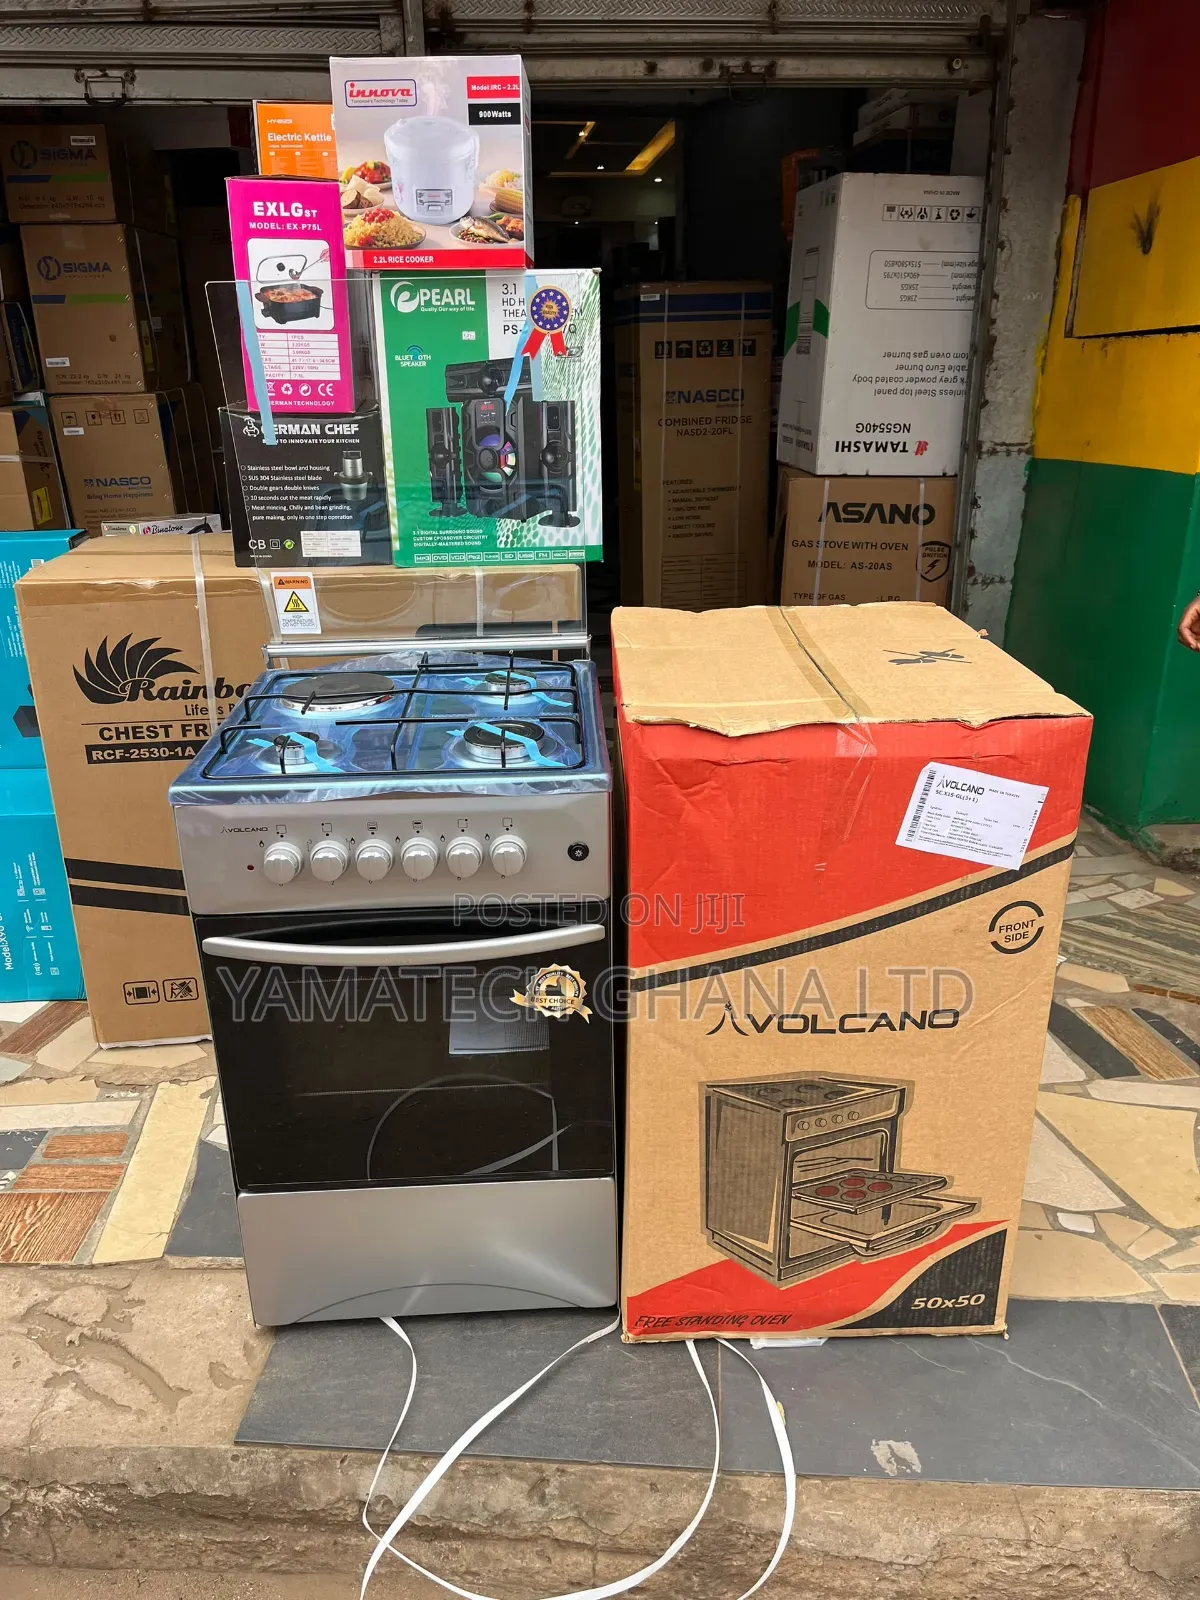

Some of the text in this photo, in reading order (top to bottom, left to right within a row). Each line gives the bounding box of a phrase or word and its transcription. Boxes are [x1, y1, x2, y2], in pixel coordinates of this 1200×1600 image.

[349, 83, 413, 98] innova
[268, 132, 332, 142] Electric Kettle
[40, 148, 97, 161] SIGMA
[249, 222, 322, 231] MODEL: EX-P75L
[373, 256, 388, 264] 2.2L
[388, 256, 404, 264] RICE
[63, 262, 112, 273] SIGMA
[502, 284, 516, 294] 3.1
[952, 283, 972, 291] weight
[420, 288, 476, 306] PEARL
[502, 298, 516, 306] HD
[882, 351, 912, 360] burner
[913, 350, 929, 358] gas
[895, 364, 946, 372] Euro burner
[852, 374, 958, 384] grey powder coated body
[678, 388, 744, 404] NASCO
[874, 387, 938, 398] Steel top panel
[658, 416, 712, 427] COMBINED
[262, 424, 359, 434] ERMAN CHEF
[676, 428, 734, 436] NASD2-20FL
[855, 422, 912, 434] NG5540G
[835, 440, 908, 452] TAMASHI
[96, 476, 151, 487] NASCO
[122, 492, 154, 500] Happiness
[818, 502, 936, 526] ASANO
[248, 539, 266, 550] CB
[792, 539, 908, 551] GAS STOVE WITH OVEN
[808, 560, 892, 571] MODEL: AS-20AS
[118, 676, 252, 702] Rainbo
[98, 724, 172, 742] CHEST
[92, 746, 196, 761] RCF-2530-1A
[944, 778, 985, 796] VOLCANO
[998, 918, 1036, 934] FRONT
[1004, 930, 1030, 943] SIDE
[746, 1008, 960, 1034] VOLCANO
[910, 1294, 986, 1310] 50x50
[634, 1314, 792, 1328] FREE STANDING OVEN
